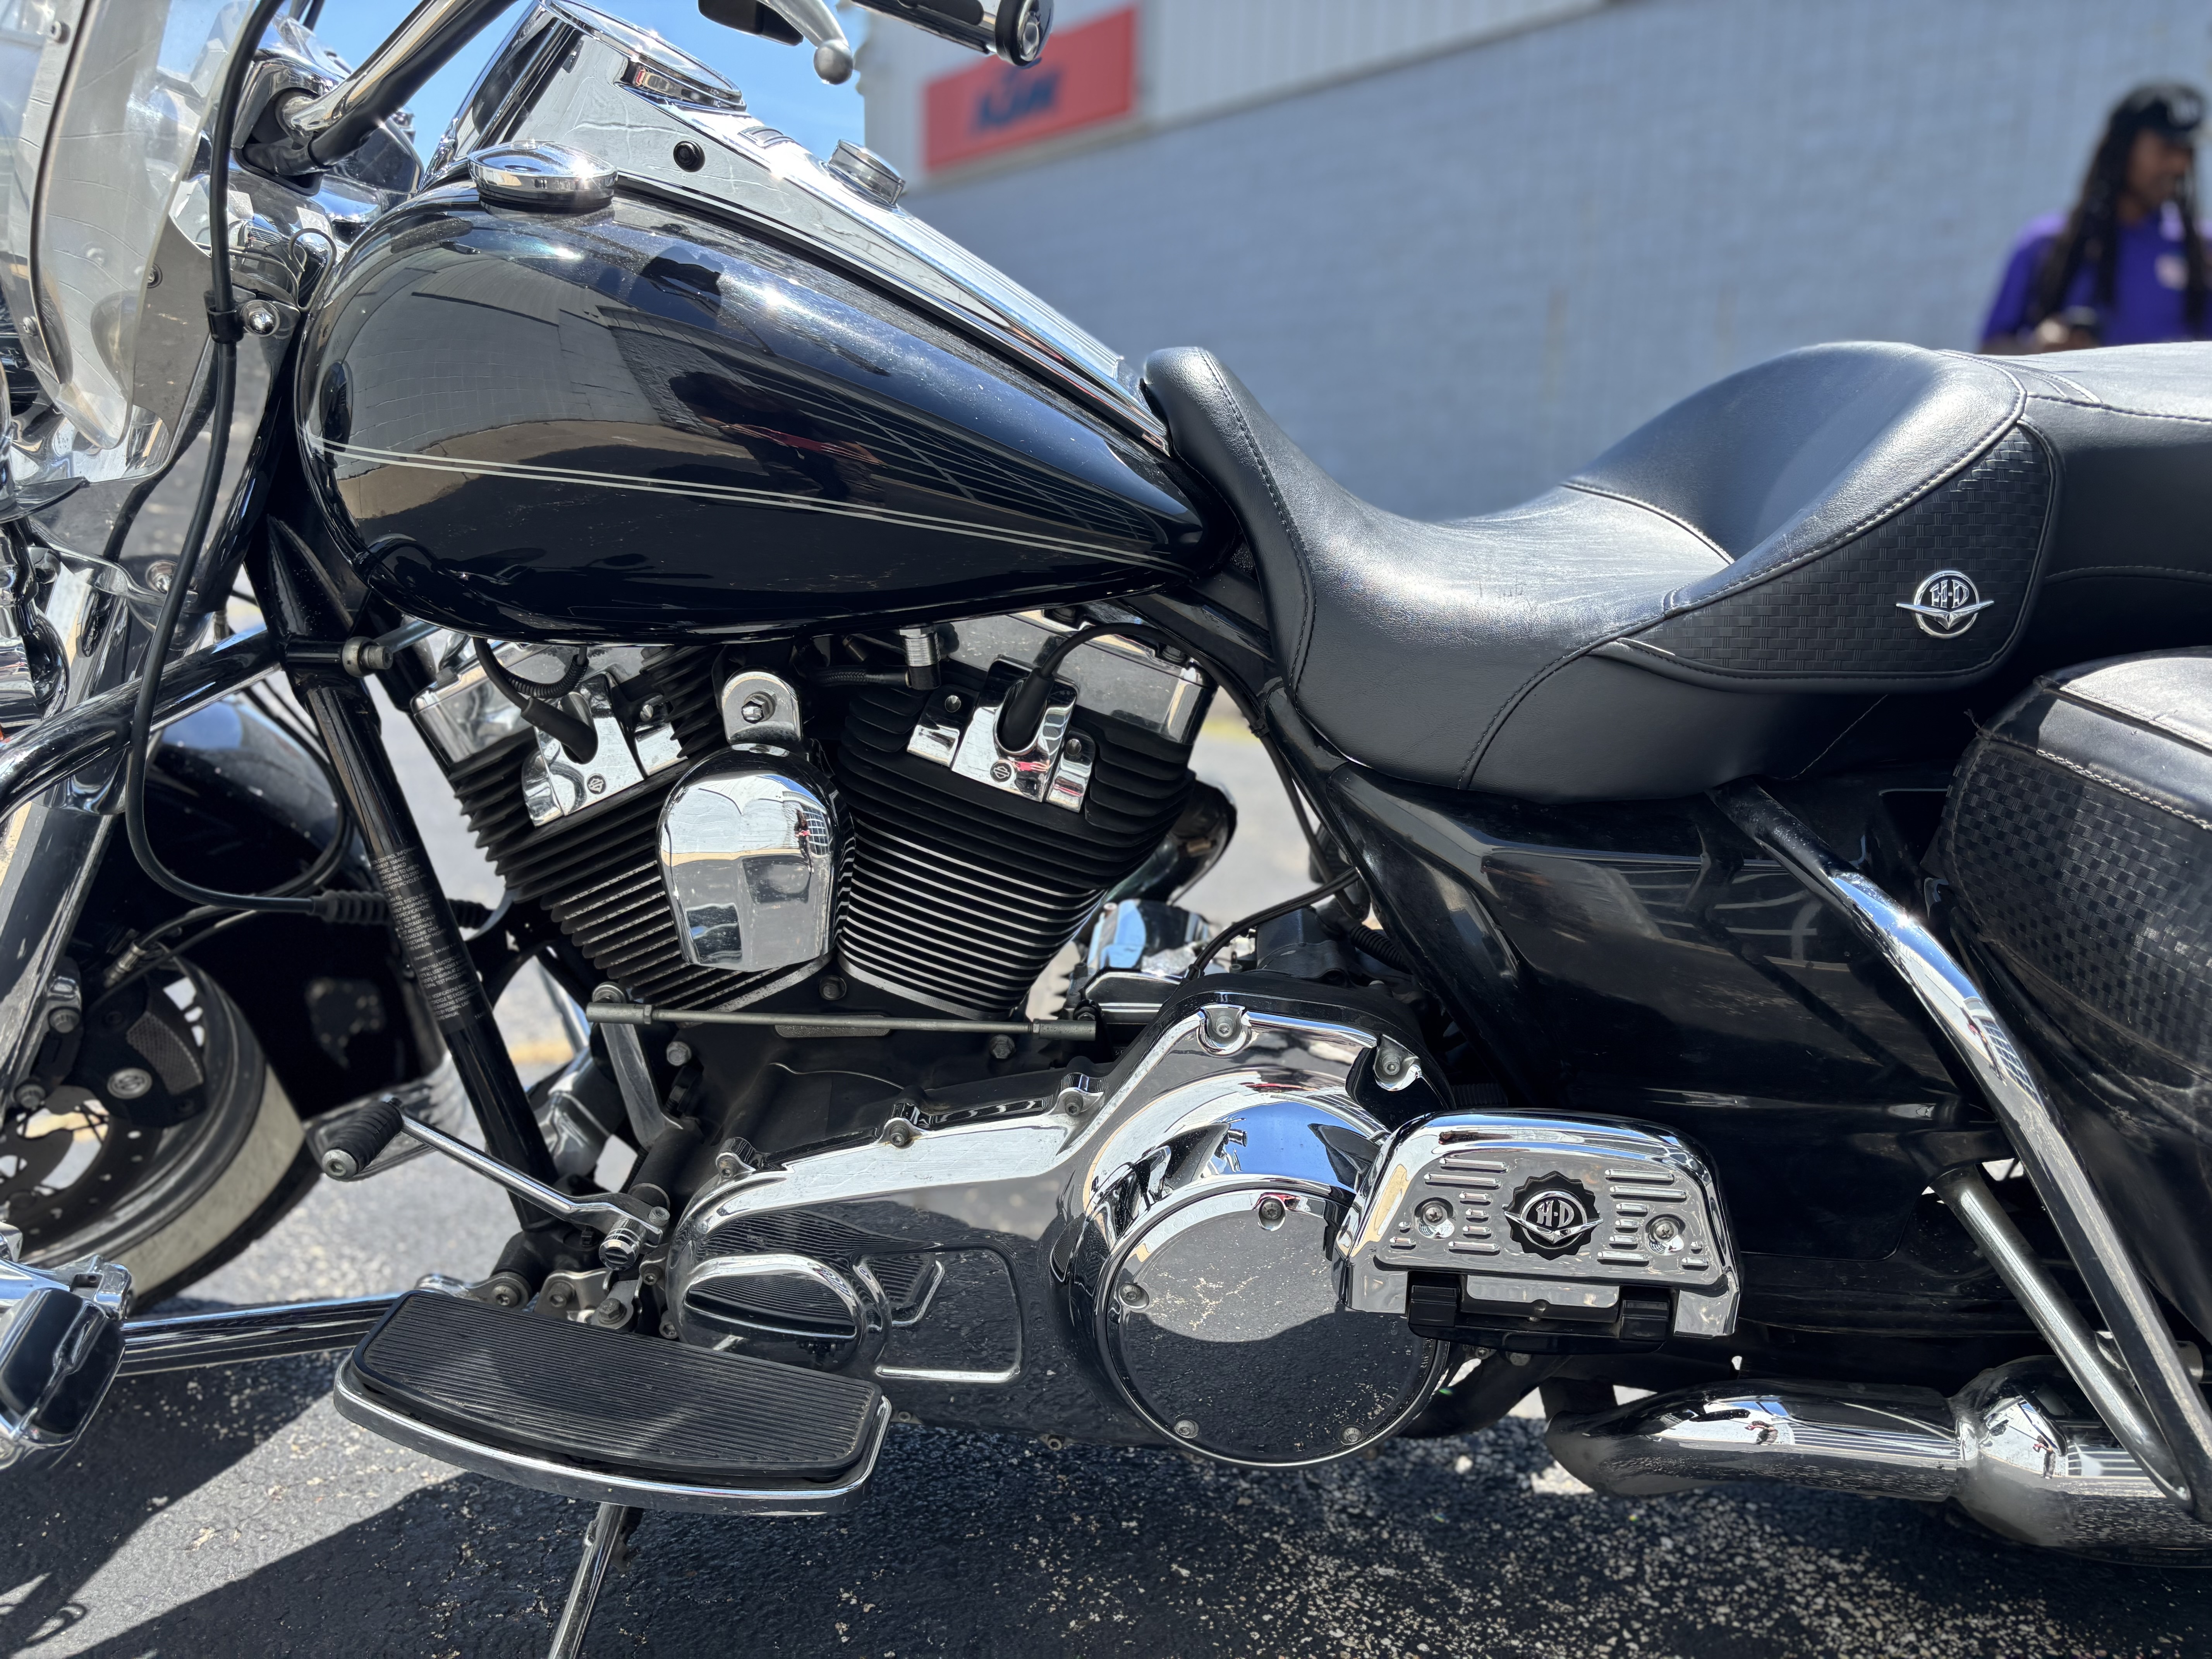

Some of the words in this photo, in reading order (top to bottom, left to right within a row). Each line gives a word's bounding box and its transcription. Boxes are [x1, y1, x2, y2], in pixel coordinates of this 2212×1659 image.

[378, 853, 397, 863] CONTROL
[389, 876, 420, 890] MOTORCYCLES
[404, 914, 436, 928] AUTOMATICALLY
[445, 1005, 462, 1013] FEDERAL
